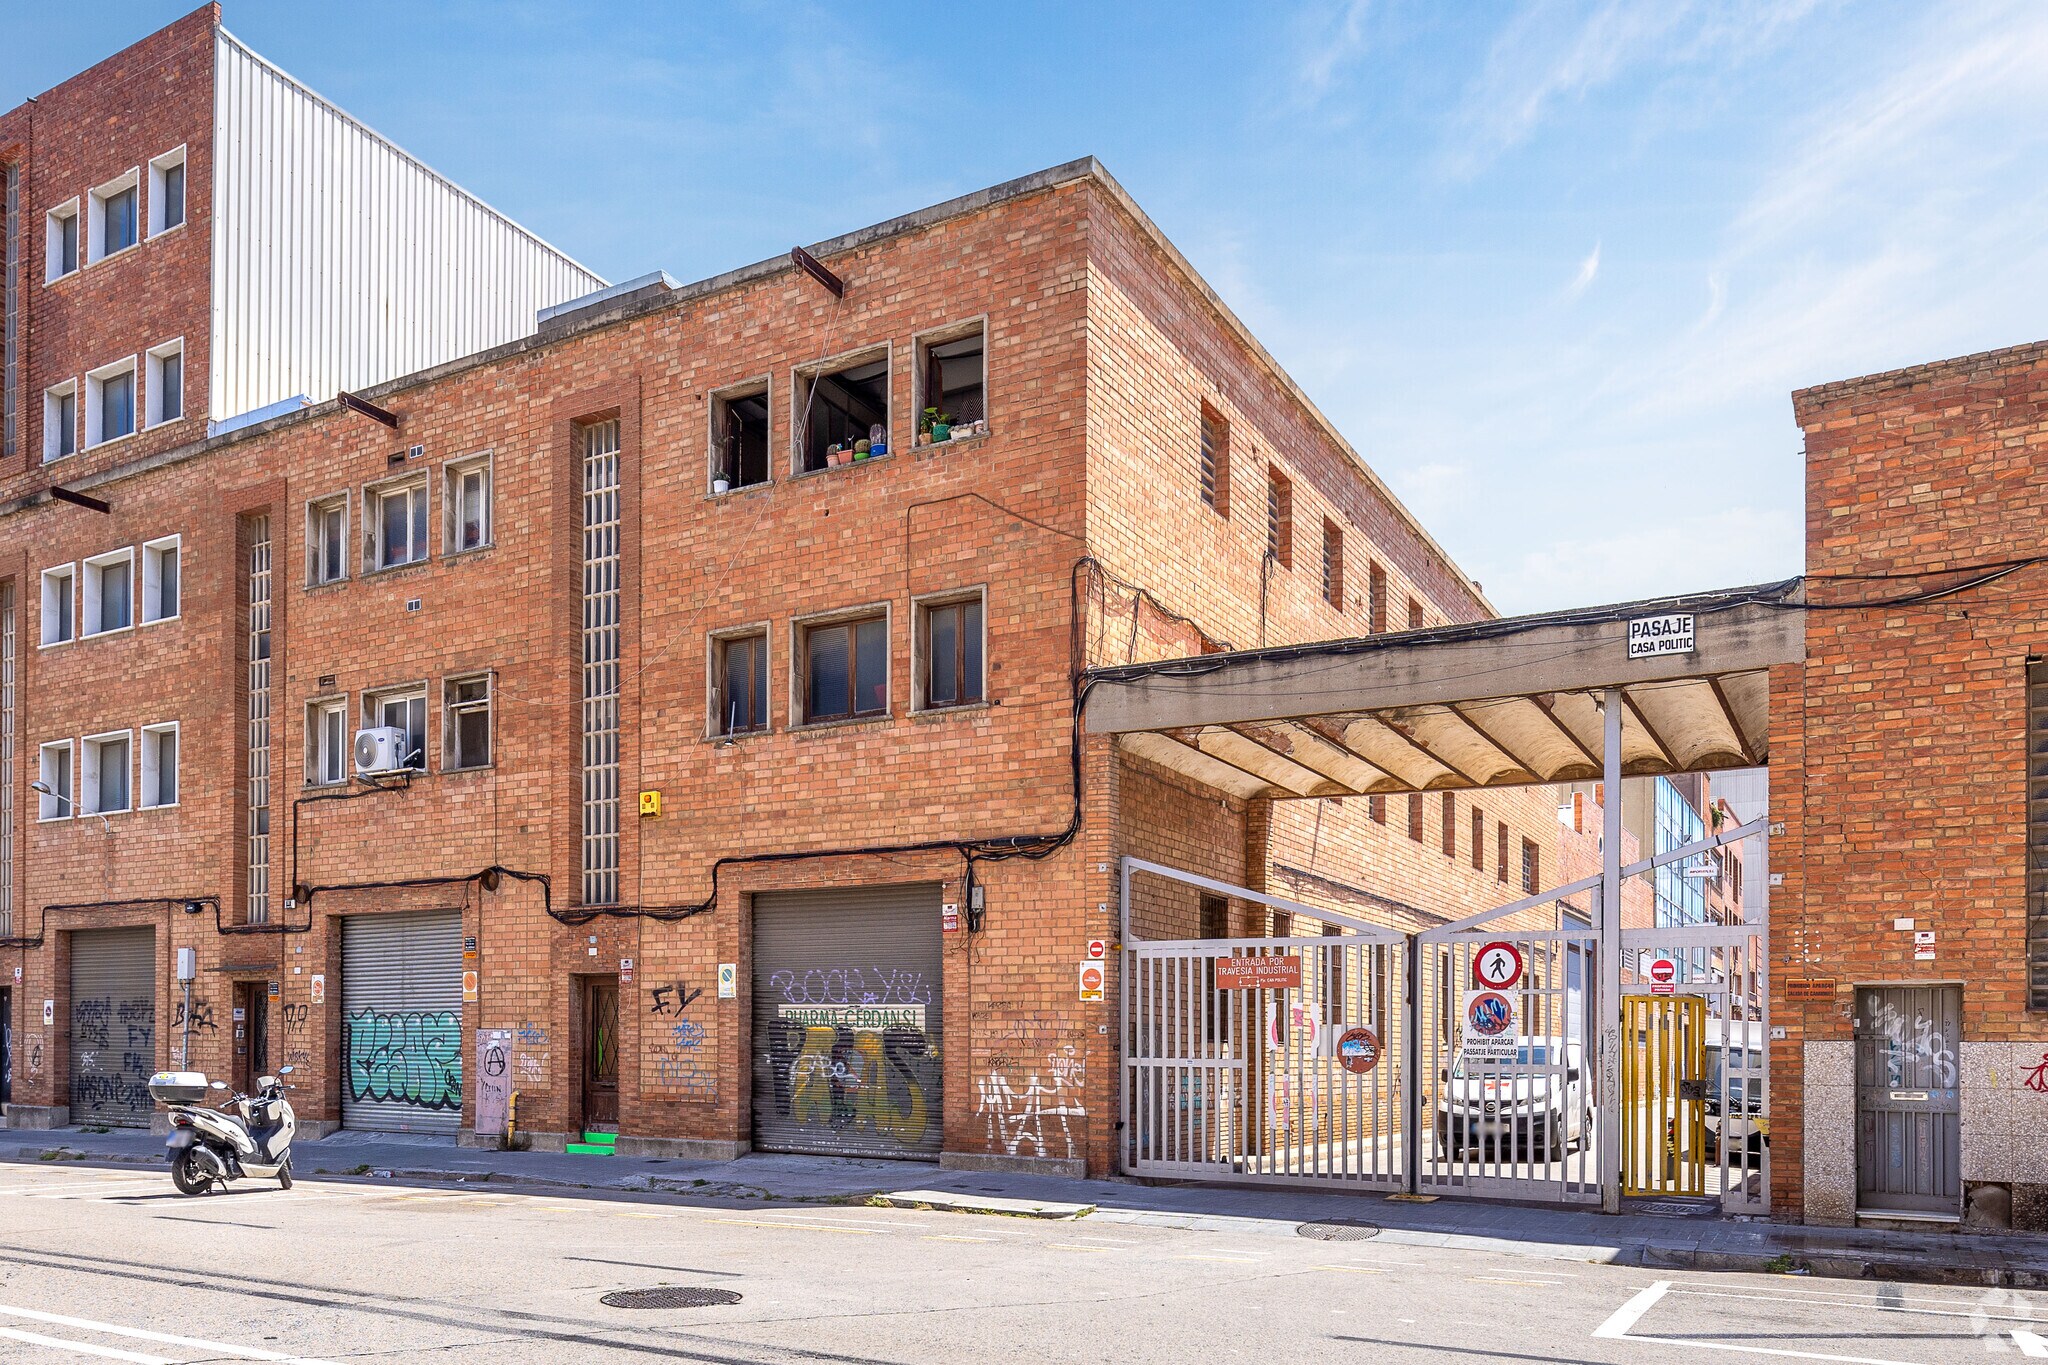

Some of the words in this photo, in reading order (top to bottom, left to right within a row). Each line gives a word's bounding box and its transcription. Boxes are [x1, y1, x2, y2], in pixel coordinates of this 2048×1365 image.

[1632, 617, 1691, 639] PASAJE
[1631, 641, 1656, 654] CASA
[1659, 638, 1693, 651] POLITIC
[1231, 958, 1266, 967] ENTRADA
[1269, 957, 1285, 966] POR
[1218, 967, 1253, 976] TRAVESIA
[1256, 965, 1299, 975] INDUSTRIAL
[1466, 1038, 1490, 1046] PROHIBIT
[1491, 1038, 1514, 1046] APARCAR
[1463, 1048, 1486, 1056] PASSATJE
[1487, 1048, 1518, 1056] PARTICULAR
